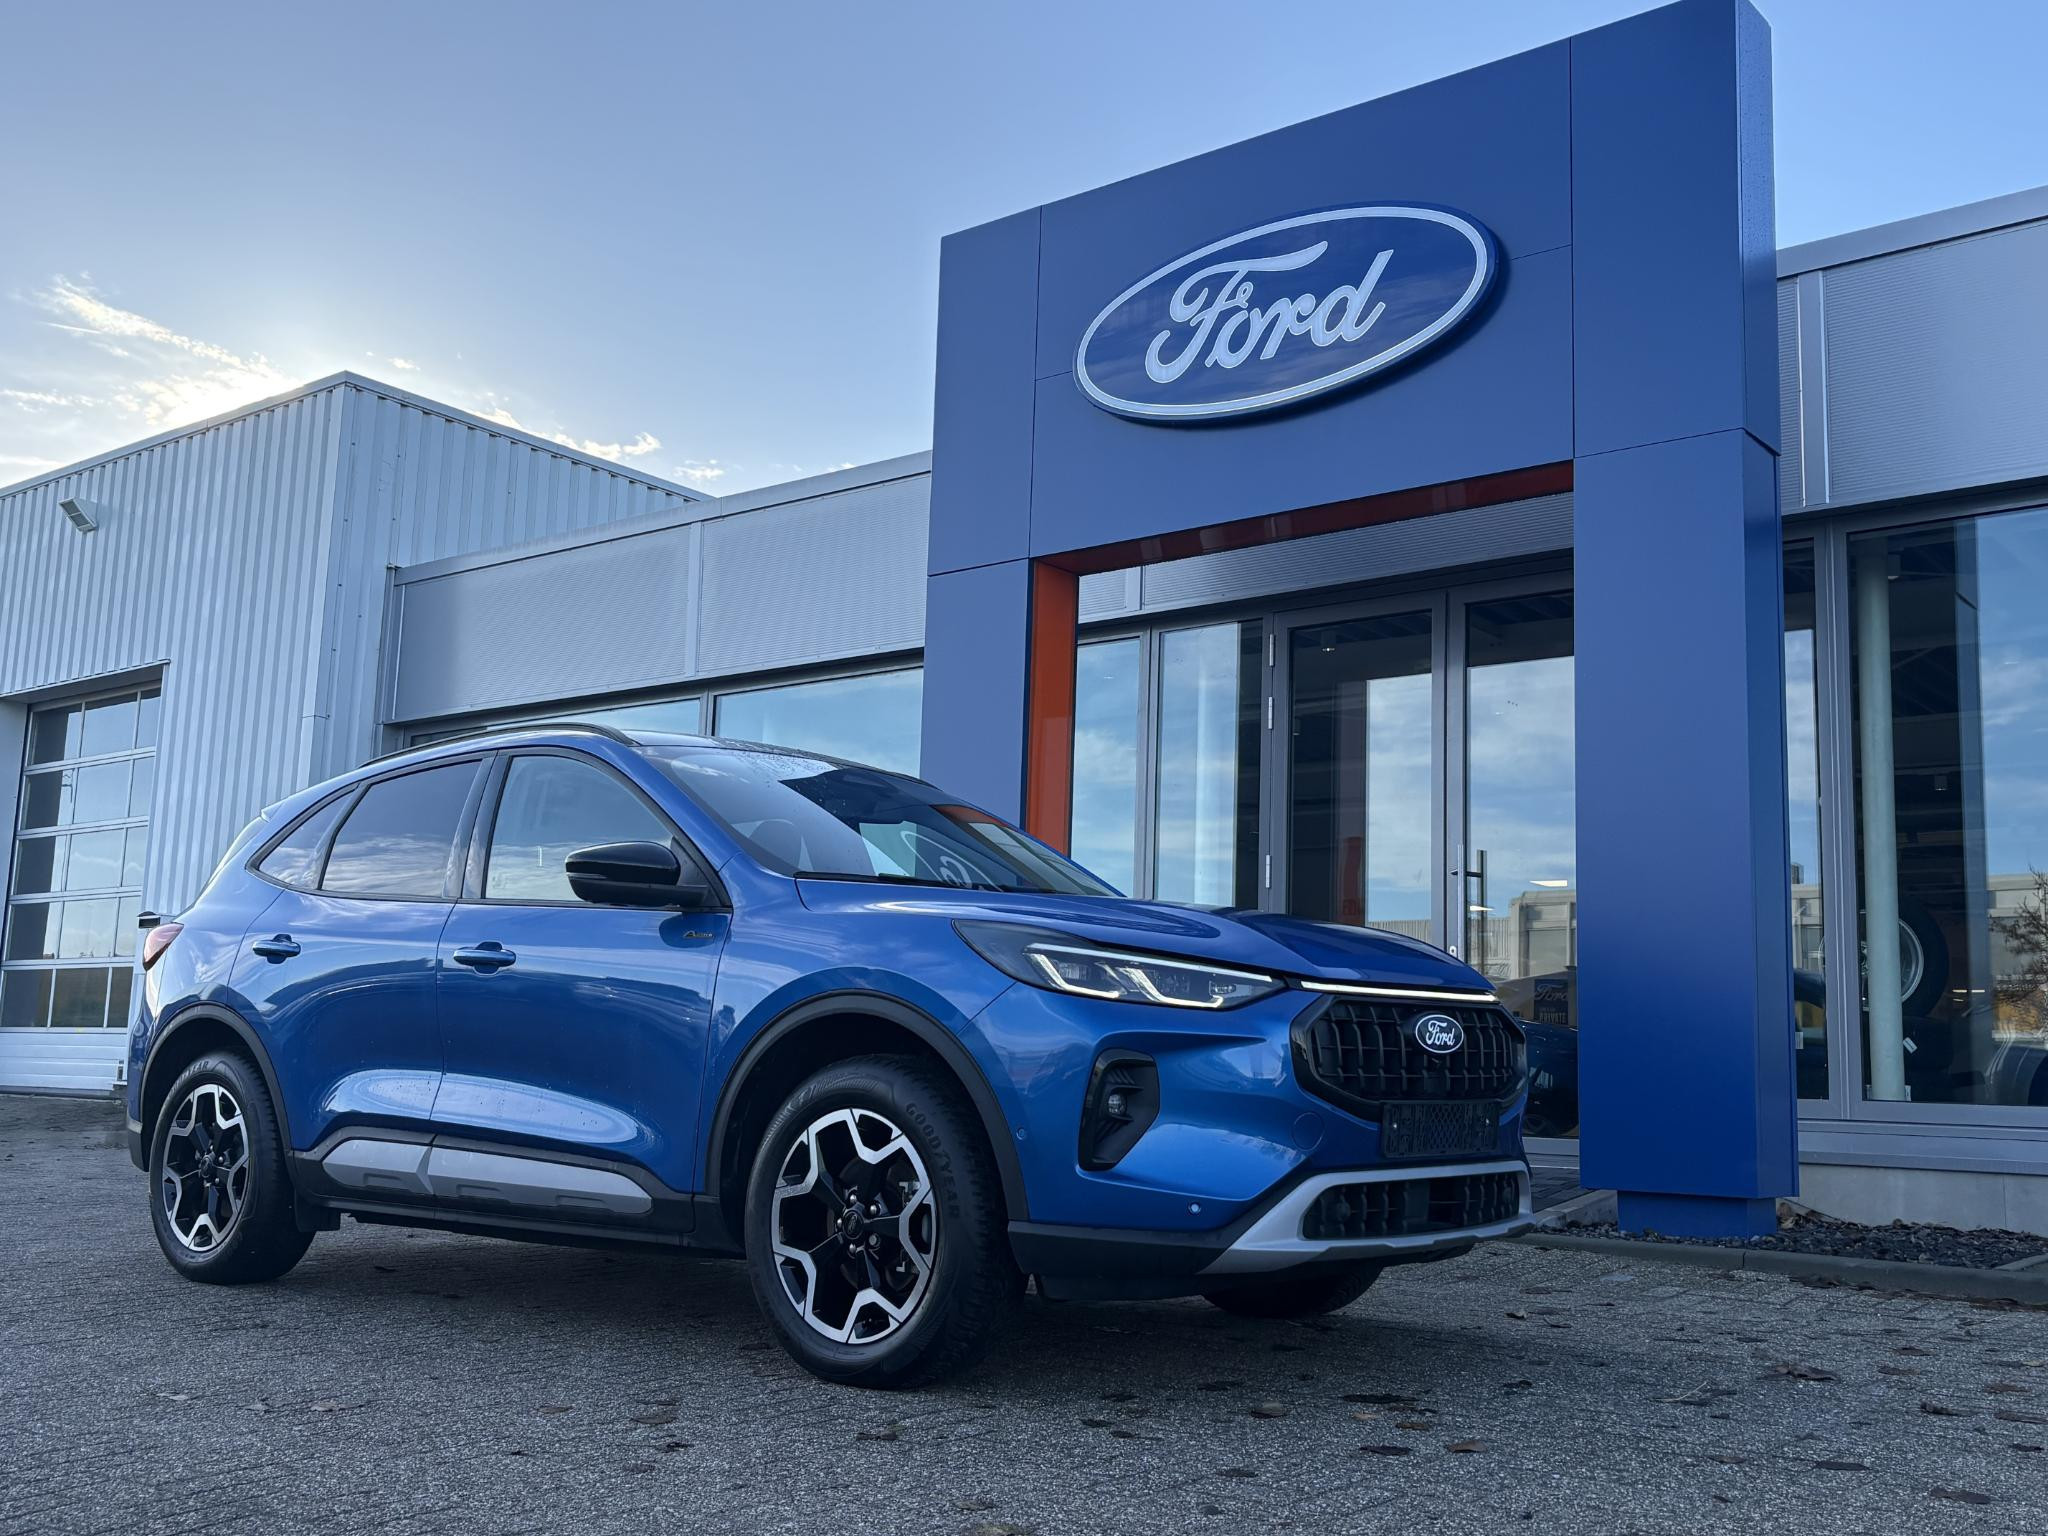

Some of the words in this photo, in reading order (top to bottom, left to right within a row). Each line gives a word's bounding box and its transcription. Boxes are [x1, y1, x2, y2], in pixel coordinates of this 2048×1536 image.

[1145, 240, 1394, 384] Ford
[1425, 1020, 1456, 1046] Ford
[905, 1102, 960, 1218] GOODYEAR
